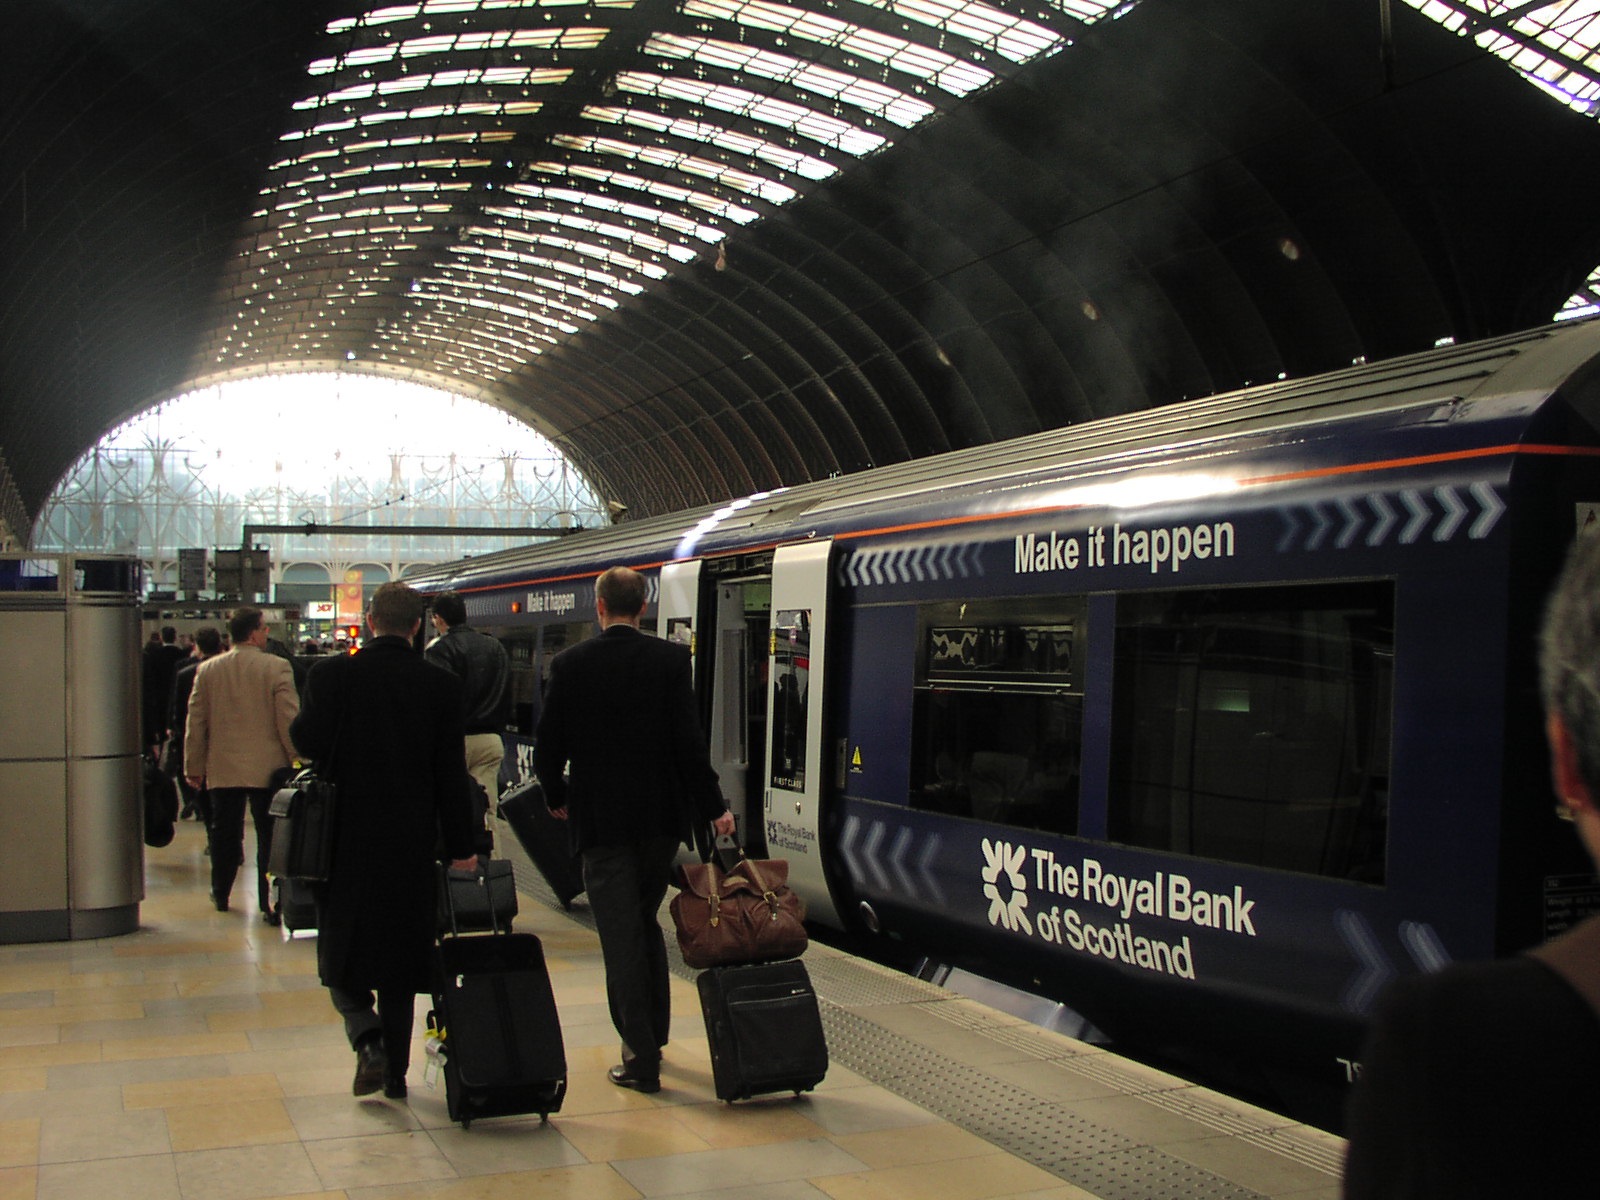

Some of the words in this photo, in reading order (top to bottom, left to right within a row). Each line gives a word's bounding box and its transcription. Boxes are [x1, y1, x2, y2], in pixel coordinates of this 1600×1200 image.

[1014, 532, 1079, 574] Make
[1087, 523, 1105, 567] it
[1113, 521, 1235, 573] happen
[1031, 848, 1079, 898] The
[1083, 858, 1162, 919] Royal
[1168, 873, 1256, 936] Bank
[1037, 906, 1063, 945] of
[1063, 908, 1195, 980] Scotland
